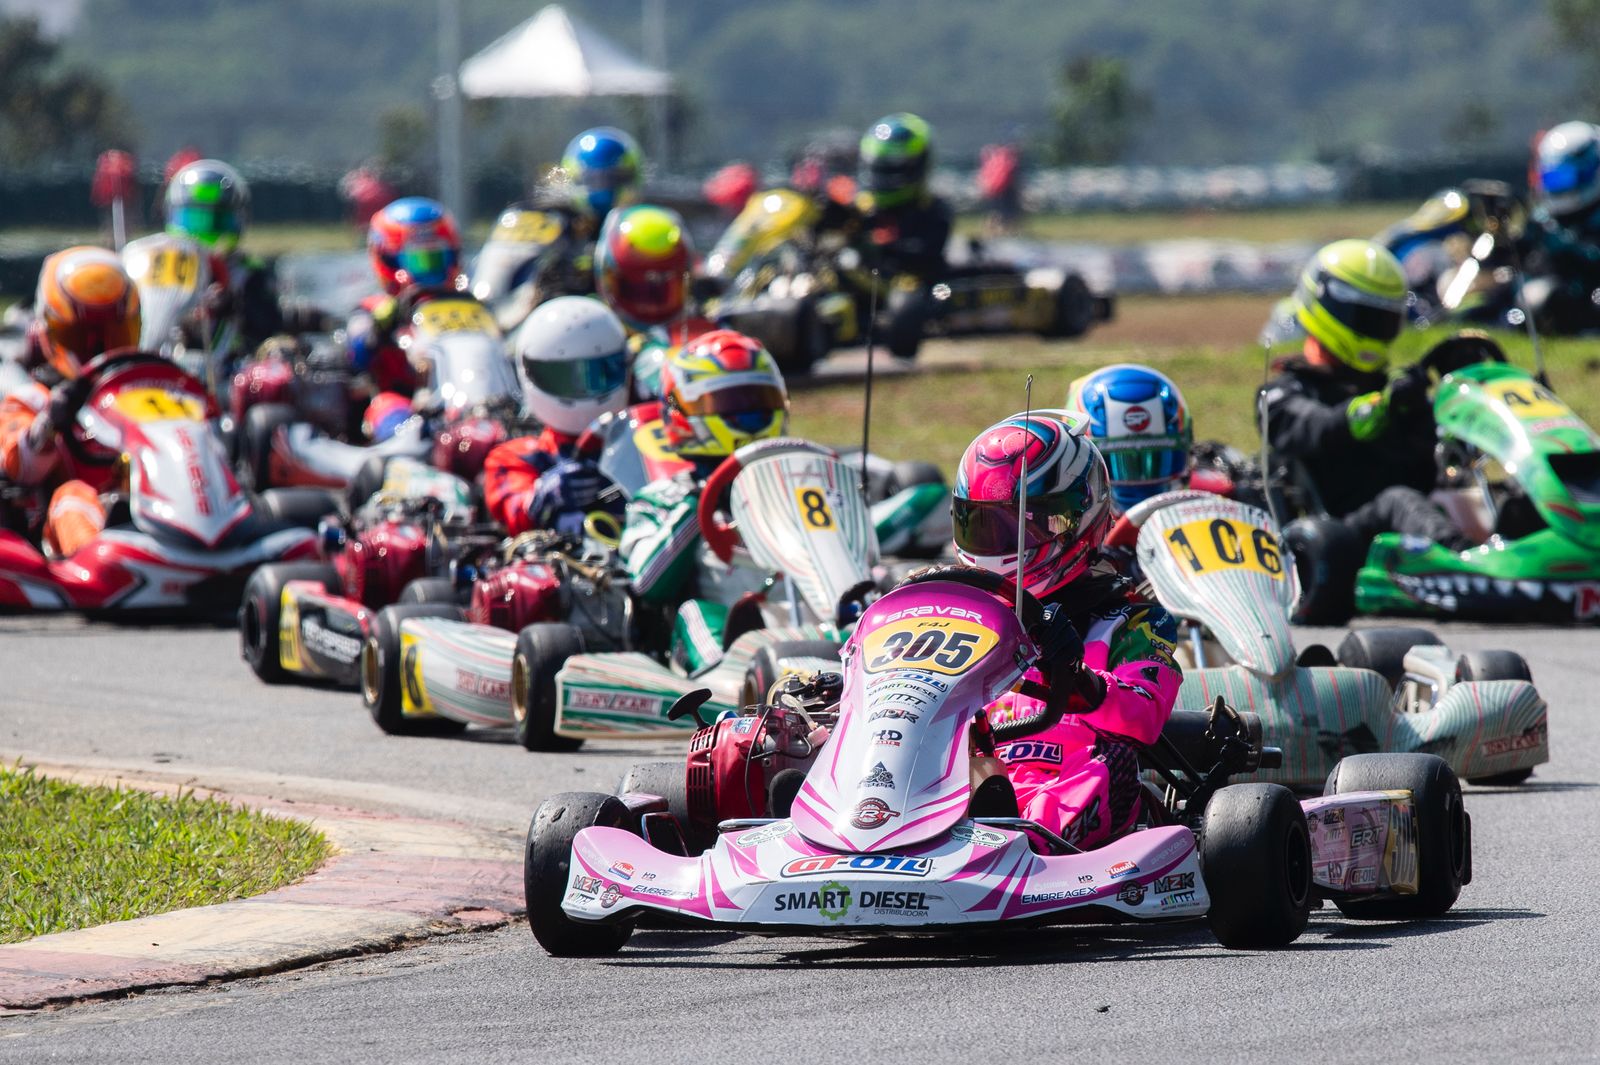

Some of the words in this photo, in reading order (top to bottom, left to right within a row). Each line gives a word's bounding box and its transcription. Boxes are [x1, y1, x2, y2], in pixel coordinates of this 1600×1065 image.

[802, 489, 831, 528] 8
[1169, 518, 1282, 574] 106
[870, 630, 980, 669] 305
[904, 683, 938, 701] DIESEL
[1350, 826, 1383, 849] ERT
[787, 855, 928, 874] GT-OIL
[572, 875, 602, 895] MZK
[1078, 874, 1094, 883] HD
[1153, 872, 1195, 894] MZK
[600, 891, 624, 902] ERT
[774, 891, 850, 912] SMART
[859, 890, 930, 911] DIESEL
[1021, 886, 1098, 904] EMBREAGEX
[1116, 887, 1149, 901] ERT
[873, 908, 929, 917] DISTRIBUIDORA
